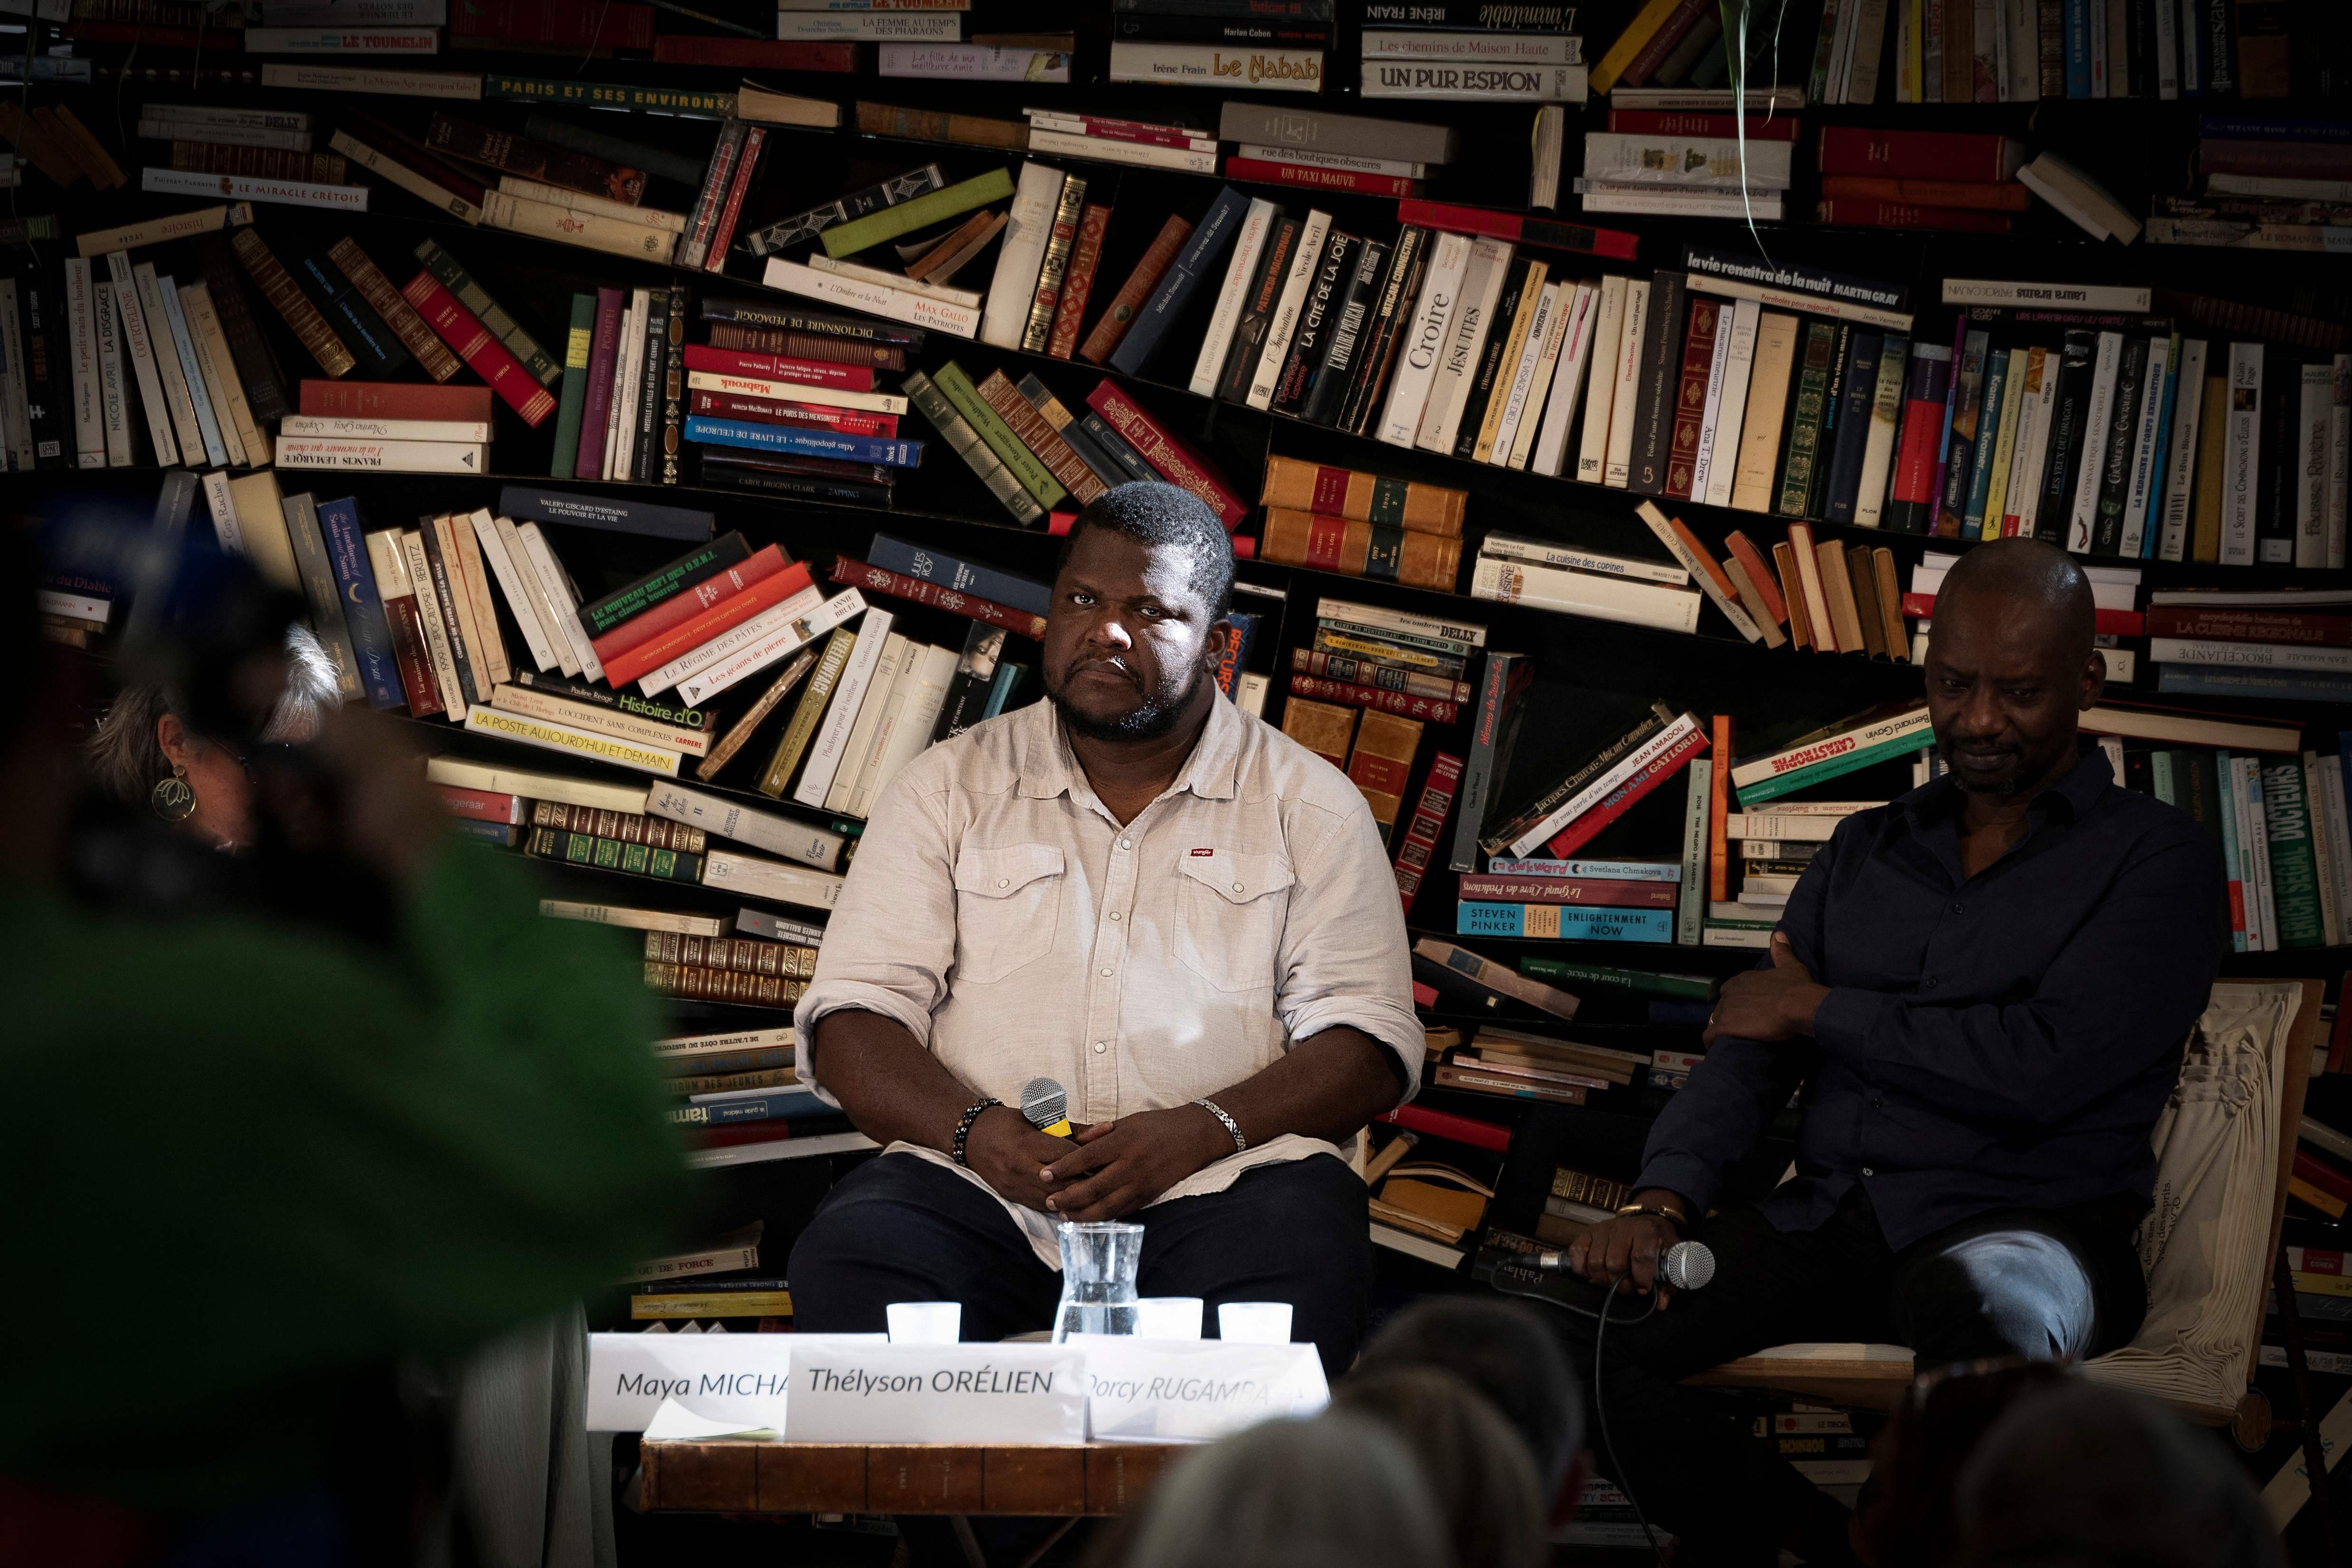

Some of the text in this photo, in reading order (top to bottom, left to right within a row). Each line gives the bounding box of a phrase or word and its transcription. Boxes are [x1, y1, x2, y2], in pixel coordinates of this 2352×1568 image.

[862, 19, 956, 28] LA FEMME AU TEMPS
[894, 28, 944, 36] PHARAONS
[343, 36, 432, 49] LE TOUMELIN
[1379, 40, 1548, 56] Les chemins de Maison Haute
[1153, 64, 1206, 75] Irène Frain
[1213, 54, 1319, 81] Le Nabab
[1380, 68, 1541, 92] UN PUR ESPION
[501, 81, 725, 110] PARIS ET SES ENVIRONS
[1262, 148, 1381, 170] rue des boutiques obscures
[1281, 169, 1355, 187] UN TAXI MAUVE
[239, 184, 359, 202] LE MIRACLE CRÉTOIS
[1295, 226, 1321, 281] Nicole Avril
[1332, 235, 1348, 263] JOIE
[1328, 263, 1339, 282] LA
[1381, 231, 1416, 317] VATICAN CONNECTION
[1687, 253, 1898, 305] la vie renaîtra de la nuit MARTIN GRAY
[830, 285, 887, 305] L'Ombre et la Nuit
[1318, 283, 1331, 300] DE
[2017, 289, 2086, 301] Laura Brams
[73, 265, 90, 374] Le petit train du bonheur
[915, 301, 968, 323] MAX GALLO
[122, 291, 147, 357] COURTELINE
[735, 310, 872, 337] DICTIONNAIRE DE PÉDAGOGIE
[914, 313, 964, 333] LES PATRIOTES
[1408, 293, 1449, 370] Croire
[1301, 330, 1316, 347] LA
[1329, 301, 1366, 371] L'AFFAIRE PÉLICAN
[1447, 307, 1481, 376] JÉSUITES
[99, 287, 120, 431] NICOLE AVRIL LA DISGRACE
[721, 379, 771, 394] Mabrouk
[540, 499, 628, 517] VALERY GISCARD D'ESTAING
[558, 508, 585, 518] POUVOIR
[1546, 552, 1624, 573] La cuisine des copines
[591, 551, 717, 621] LE NOUVEAU DEFI DES O.V.N.I.
[832, 594, 854, 610] ANNIE
[834, 603, 858, 619] BRUEL
[1440, 627, 1477, 642] DELLY
[664, 623, 763, 680] LE RÉGIME DES PÂTES
[709, 637, 787, 684] Les géants de pierre
[2179, 649, 2272, 664] BROCELIANDE
[571, 686, 613, 703] Pauline Réage
[620, 694, 702, 727] Histoire d'O
[476, 713, 670, 768] LA POSTE AUJOURD'HUI ET DEMAIN
[1631, 724, 1684, 767] JEAN AMADOU
[1771, 737, 1855, 773] CATASTROPHE
[1602, 732, 1698, 809] MON AMI GAYLORD
[2262, 764, 2318, 941] ERICH SEGAL DOCTEURS
[1508, 860, 1568, 874] awkward
[1623, 867, 1661, 876] Chmakova
[1472, 909, 1516, 919] STEVEN
[1568, 913, 1647, 923] ENLIGHTENMENT
[1472, 922, 1515, 931] PINKER
[1590, 926, 1623, 936] NOW
[638, 1259, 713, 1275] OU DE FORCE
[2311, 1261, 2334, 1269] COHEN
[617, 1374, 690, 1401] Maya
[809, 1365, 1053, 1395] Thélyson ORÉLIEN
